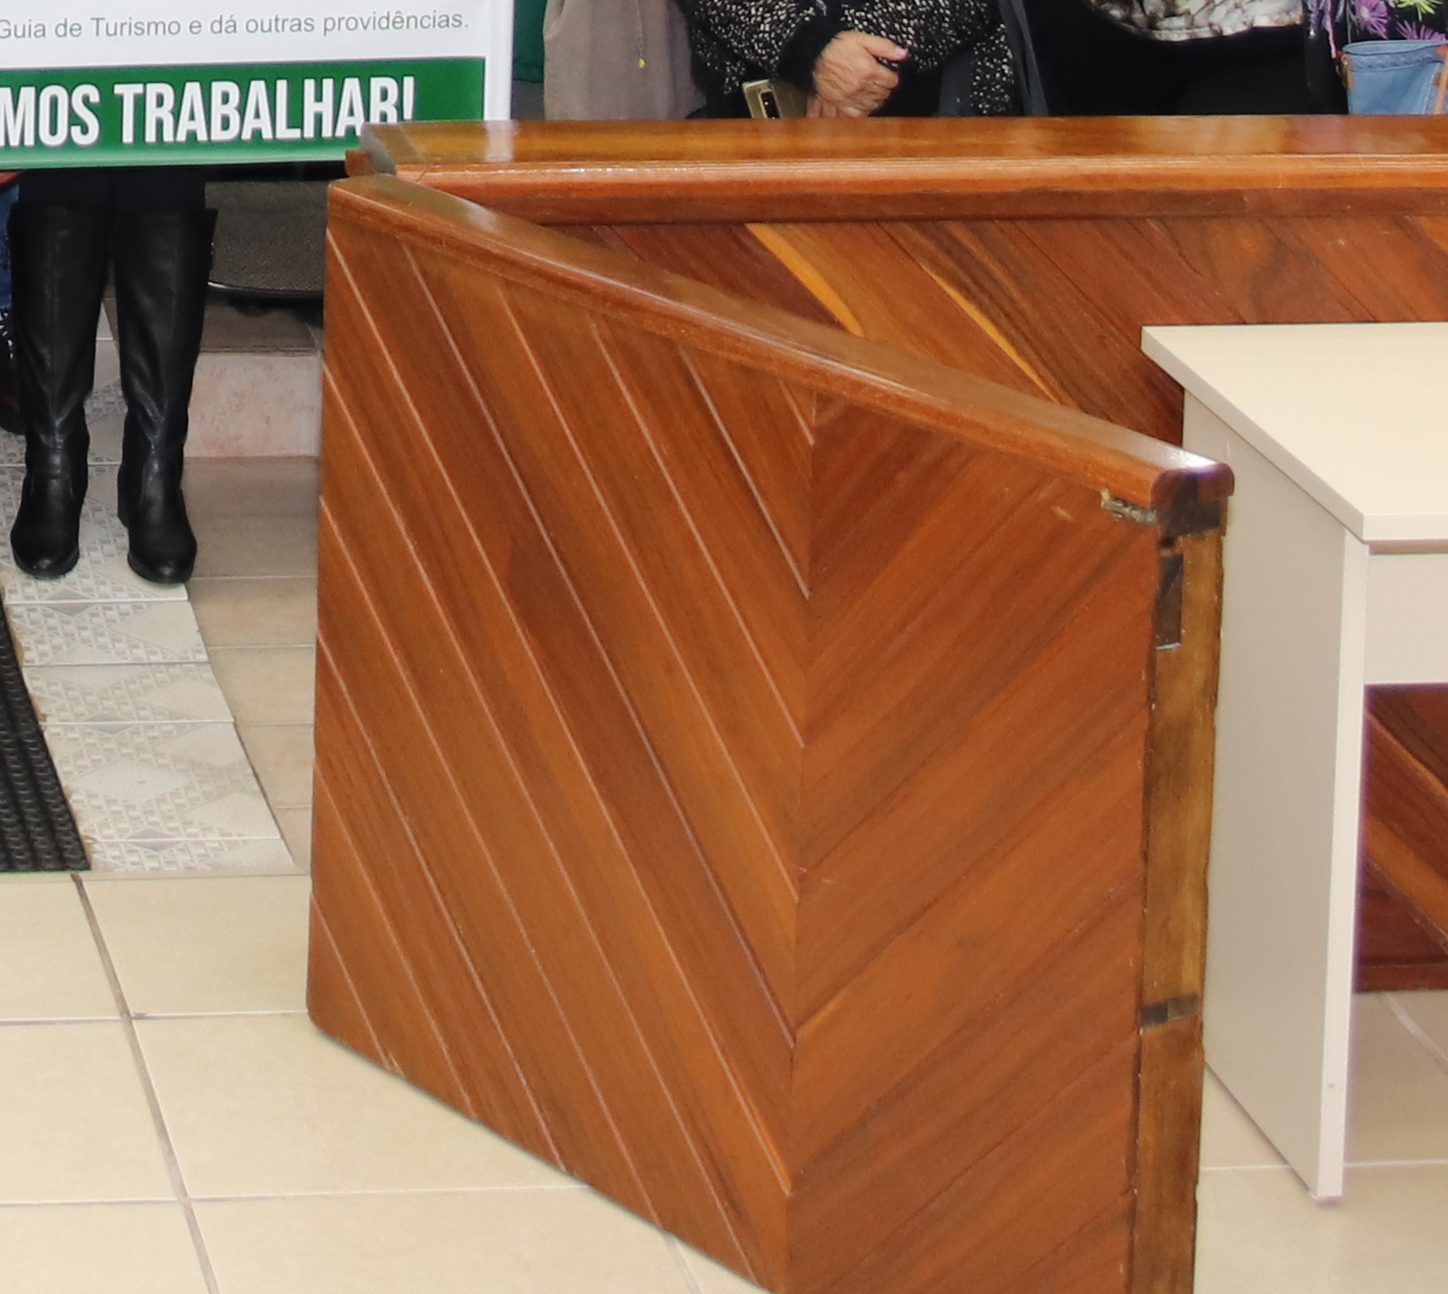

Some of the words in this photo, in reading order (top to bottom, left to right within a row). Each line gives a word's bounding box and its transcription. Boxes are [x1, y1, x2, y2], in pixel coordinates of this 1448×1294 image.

[54, 18, 83, 38] de
[90, 16, 182, 37] Turismo
[188, 19, 203, 35] e
[209, 14, 238, 35] dá
[245, 14, 316, 34] outras
[323, 9, 469, 37] providências.
[114, 76, 416, 145] TRABALHAR!
